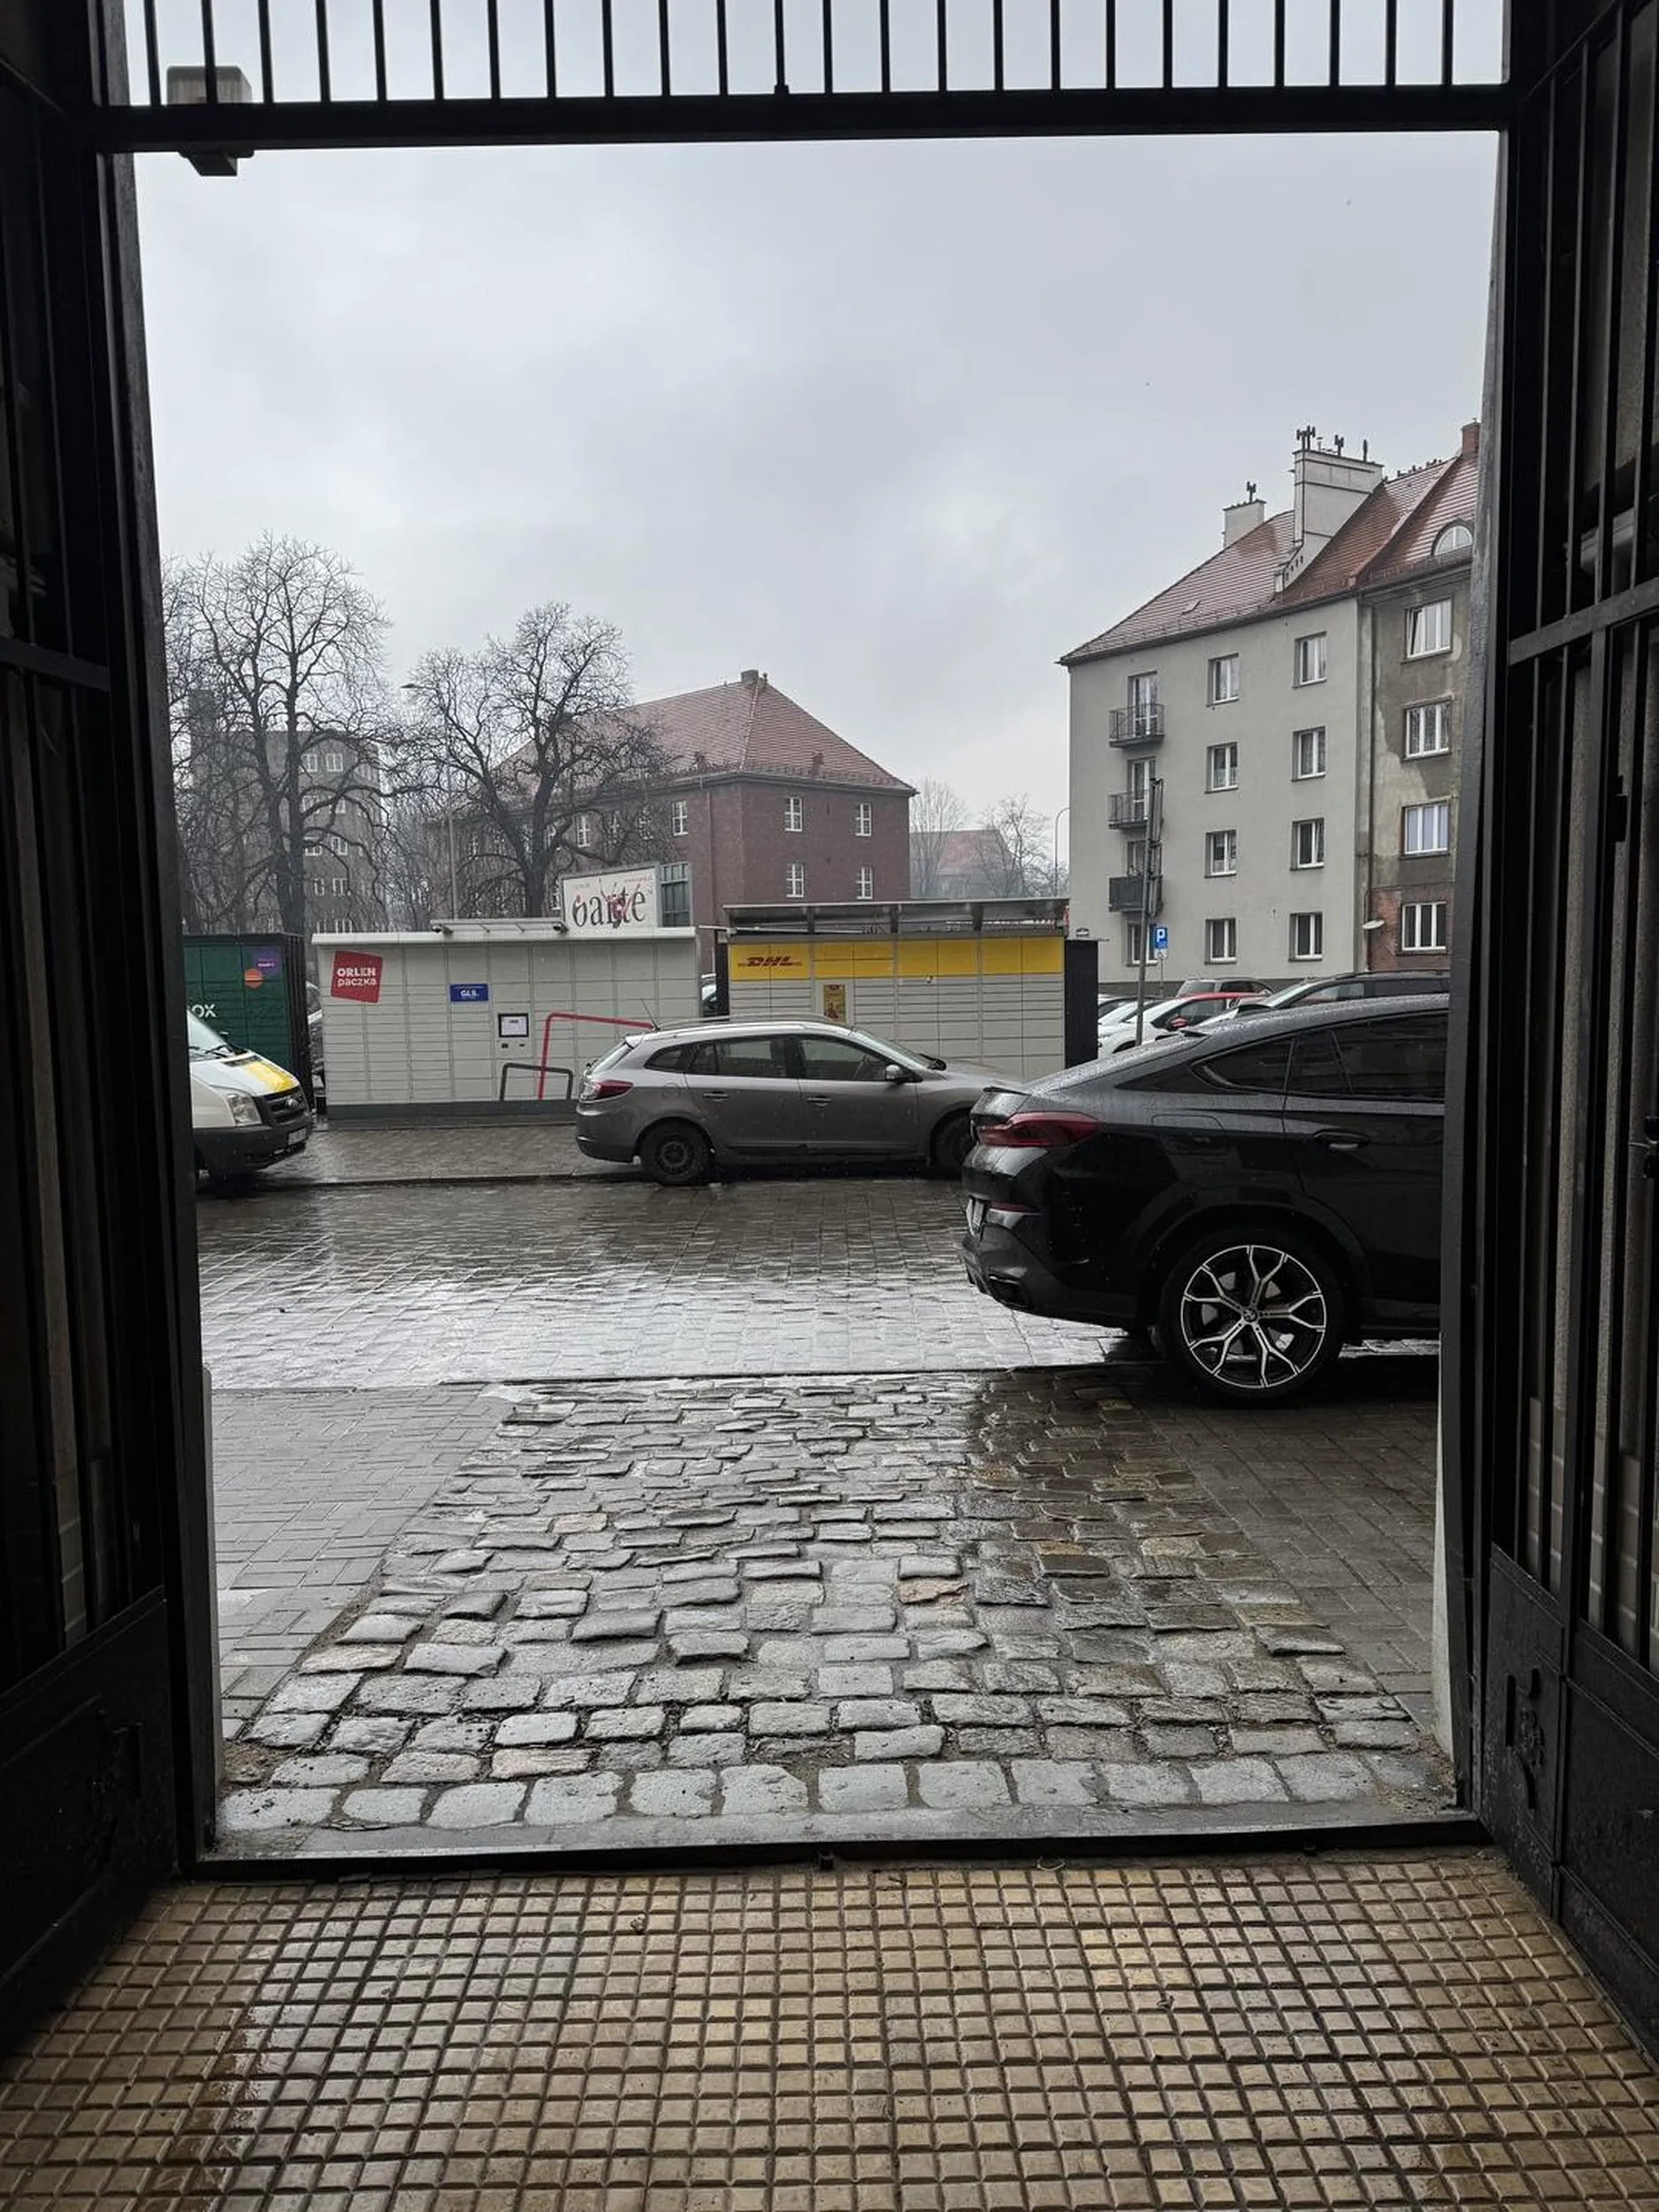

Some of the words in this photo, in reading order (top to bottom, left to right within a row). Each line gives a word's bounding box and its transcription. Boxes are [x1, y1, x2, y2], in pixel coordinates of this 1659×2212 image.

[1156, 928, 1165, 942] P
[747, 956, 790, 967] DHL
[336, 967, 376, 977] ORLEN
[187, 1004, 217, 1018] OX
